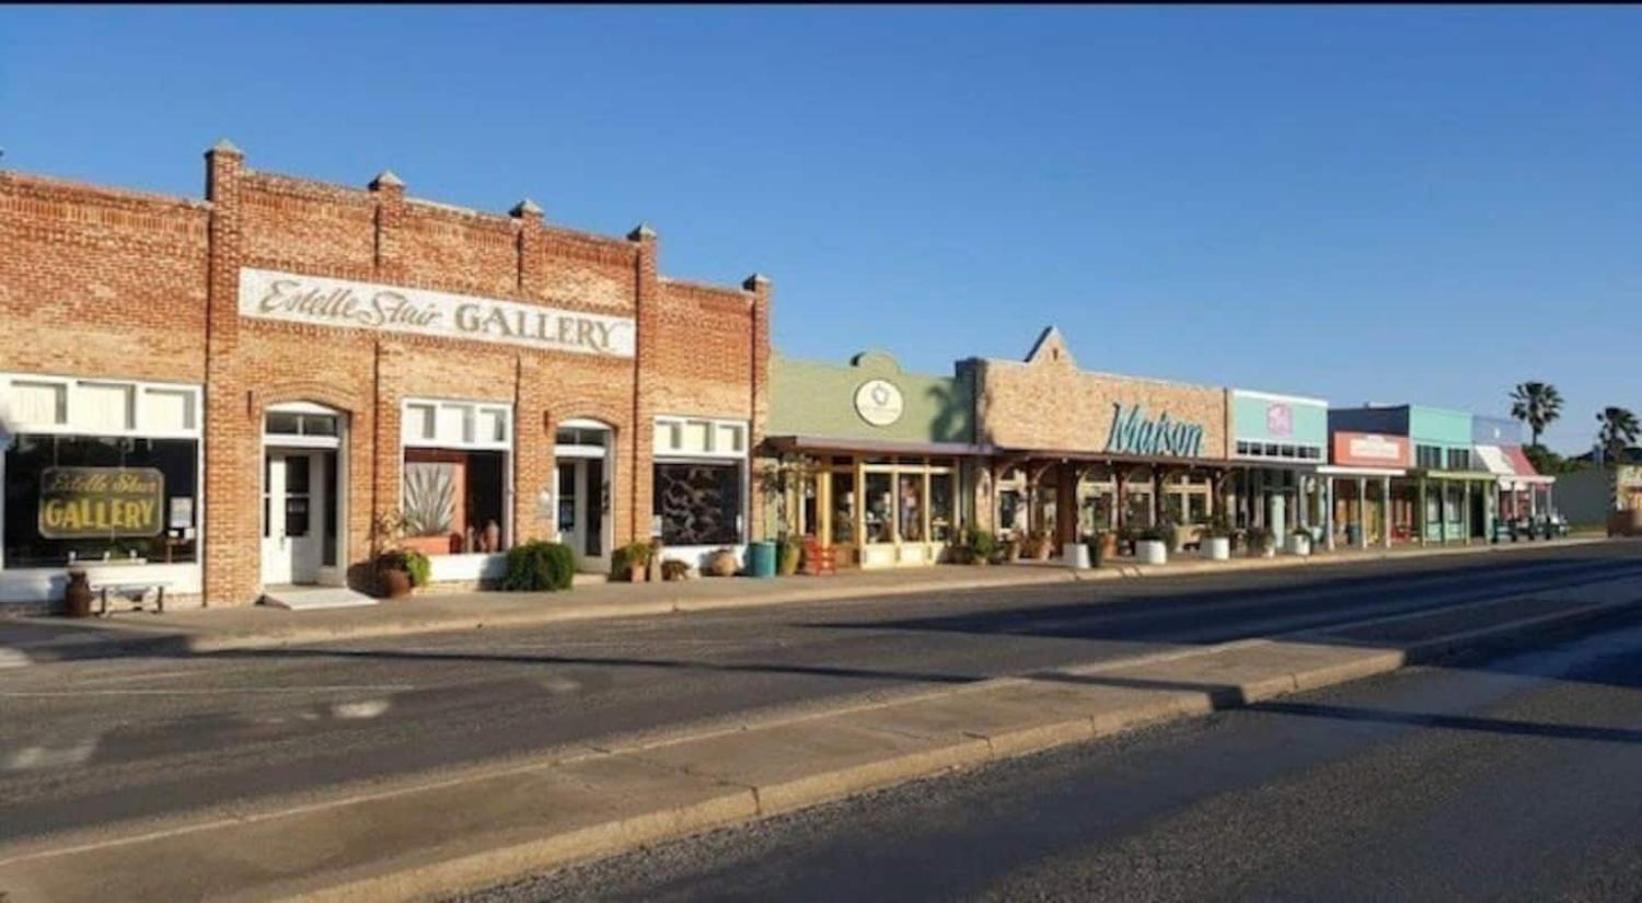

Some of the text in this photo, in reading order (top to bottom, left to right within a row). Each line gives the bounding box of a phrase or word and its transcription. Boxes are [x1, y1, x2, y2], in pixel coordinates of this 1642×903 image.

[259, 278, 621, 351] Estelle Stair GALLERY
[1105, 402, 1203, 457] Maison
[45, 498, 156, 530] GALLERY
